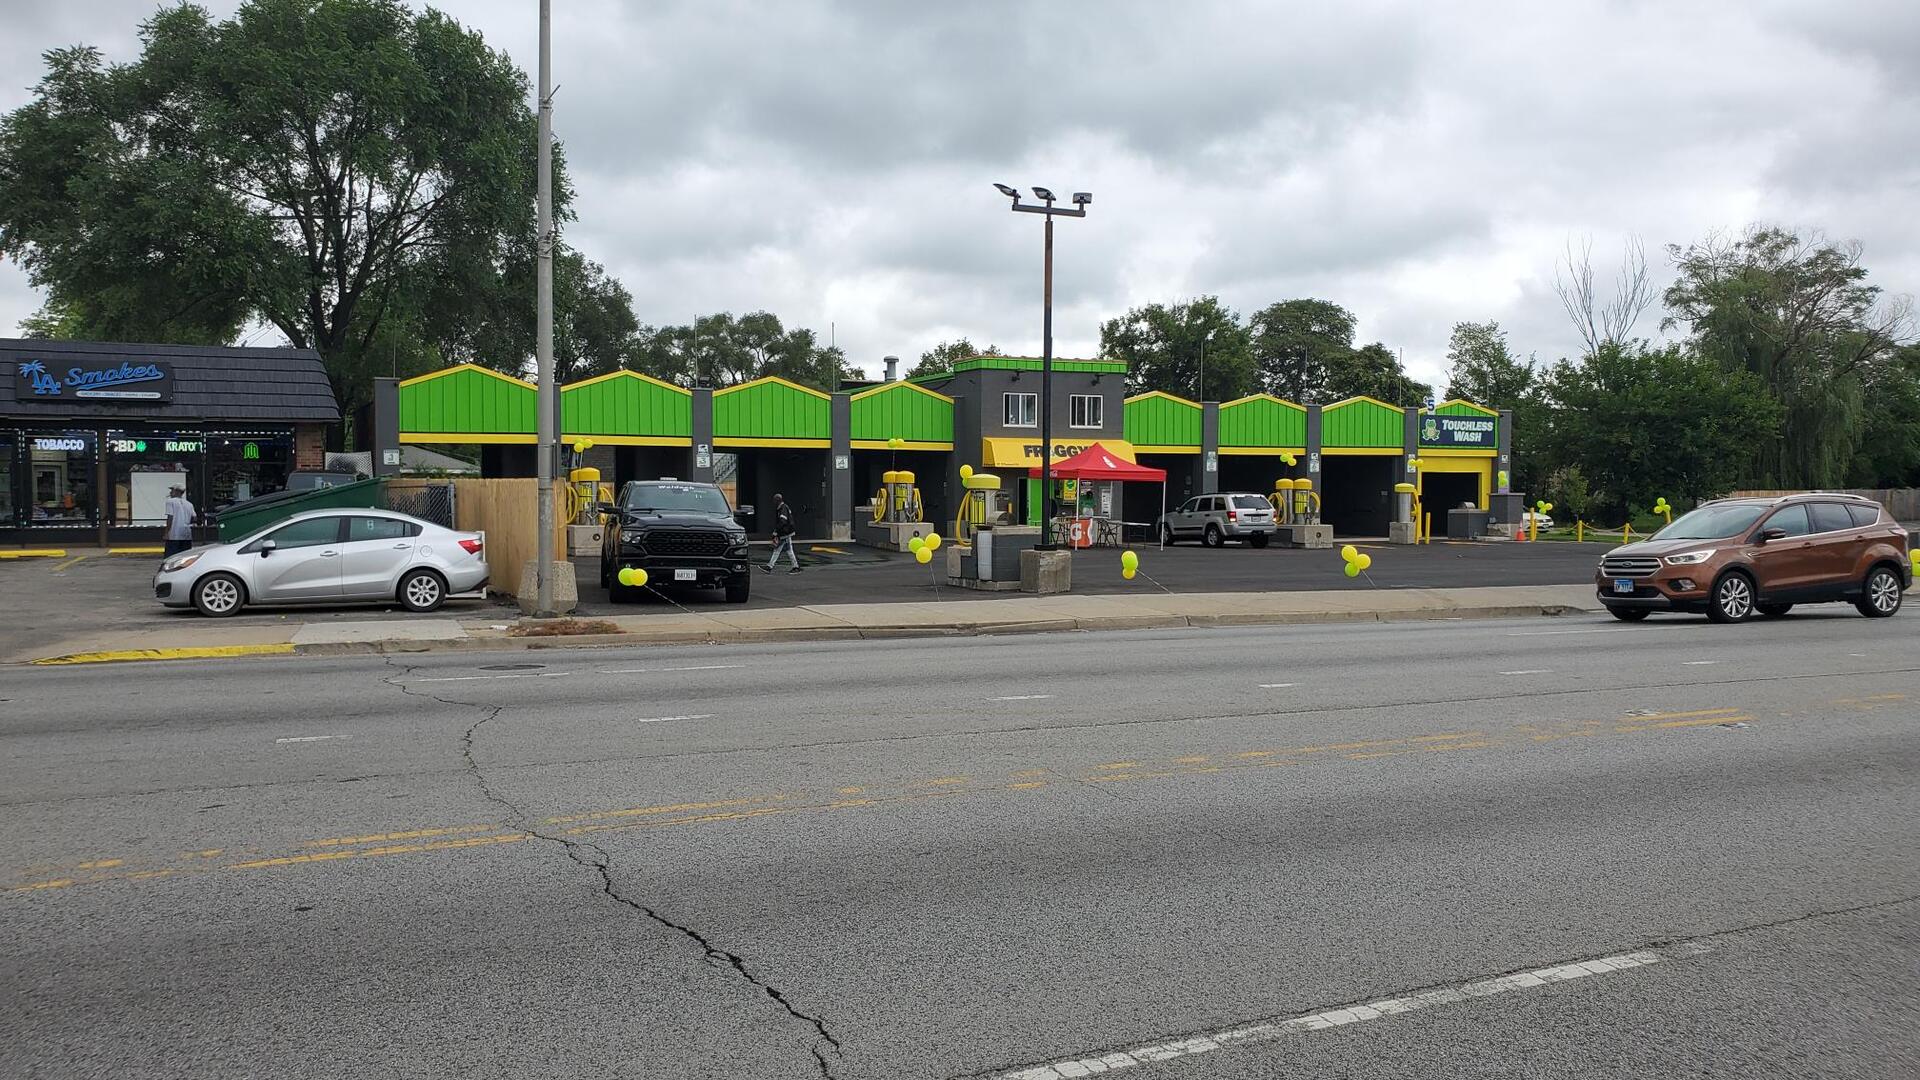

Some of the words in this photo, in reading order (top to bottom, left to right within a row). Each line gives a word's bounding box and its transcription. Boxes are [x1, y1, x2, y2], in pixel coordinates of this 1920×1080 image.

[29, 366, 61, 394] LA
[64, 360, 160, 386] Smokes
[1442, 419, 1494, 431] TOUCHLESS
[1454, 431, 1482, 442] WASH
[34, 438, 84, 450] TOBACCO
[109, 440, 136, 452] CBD
